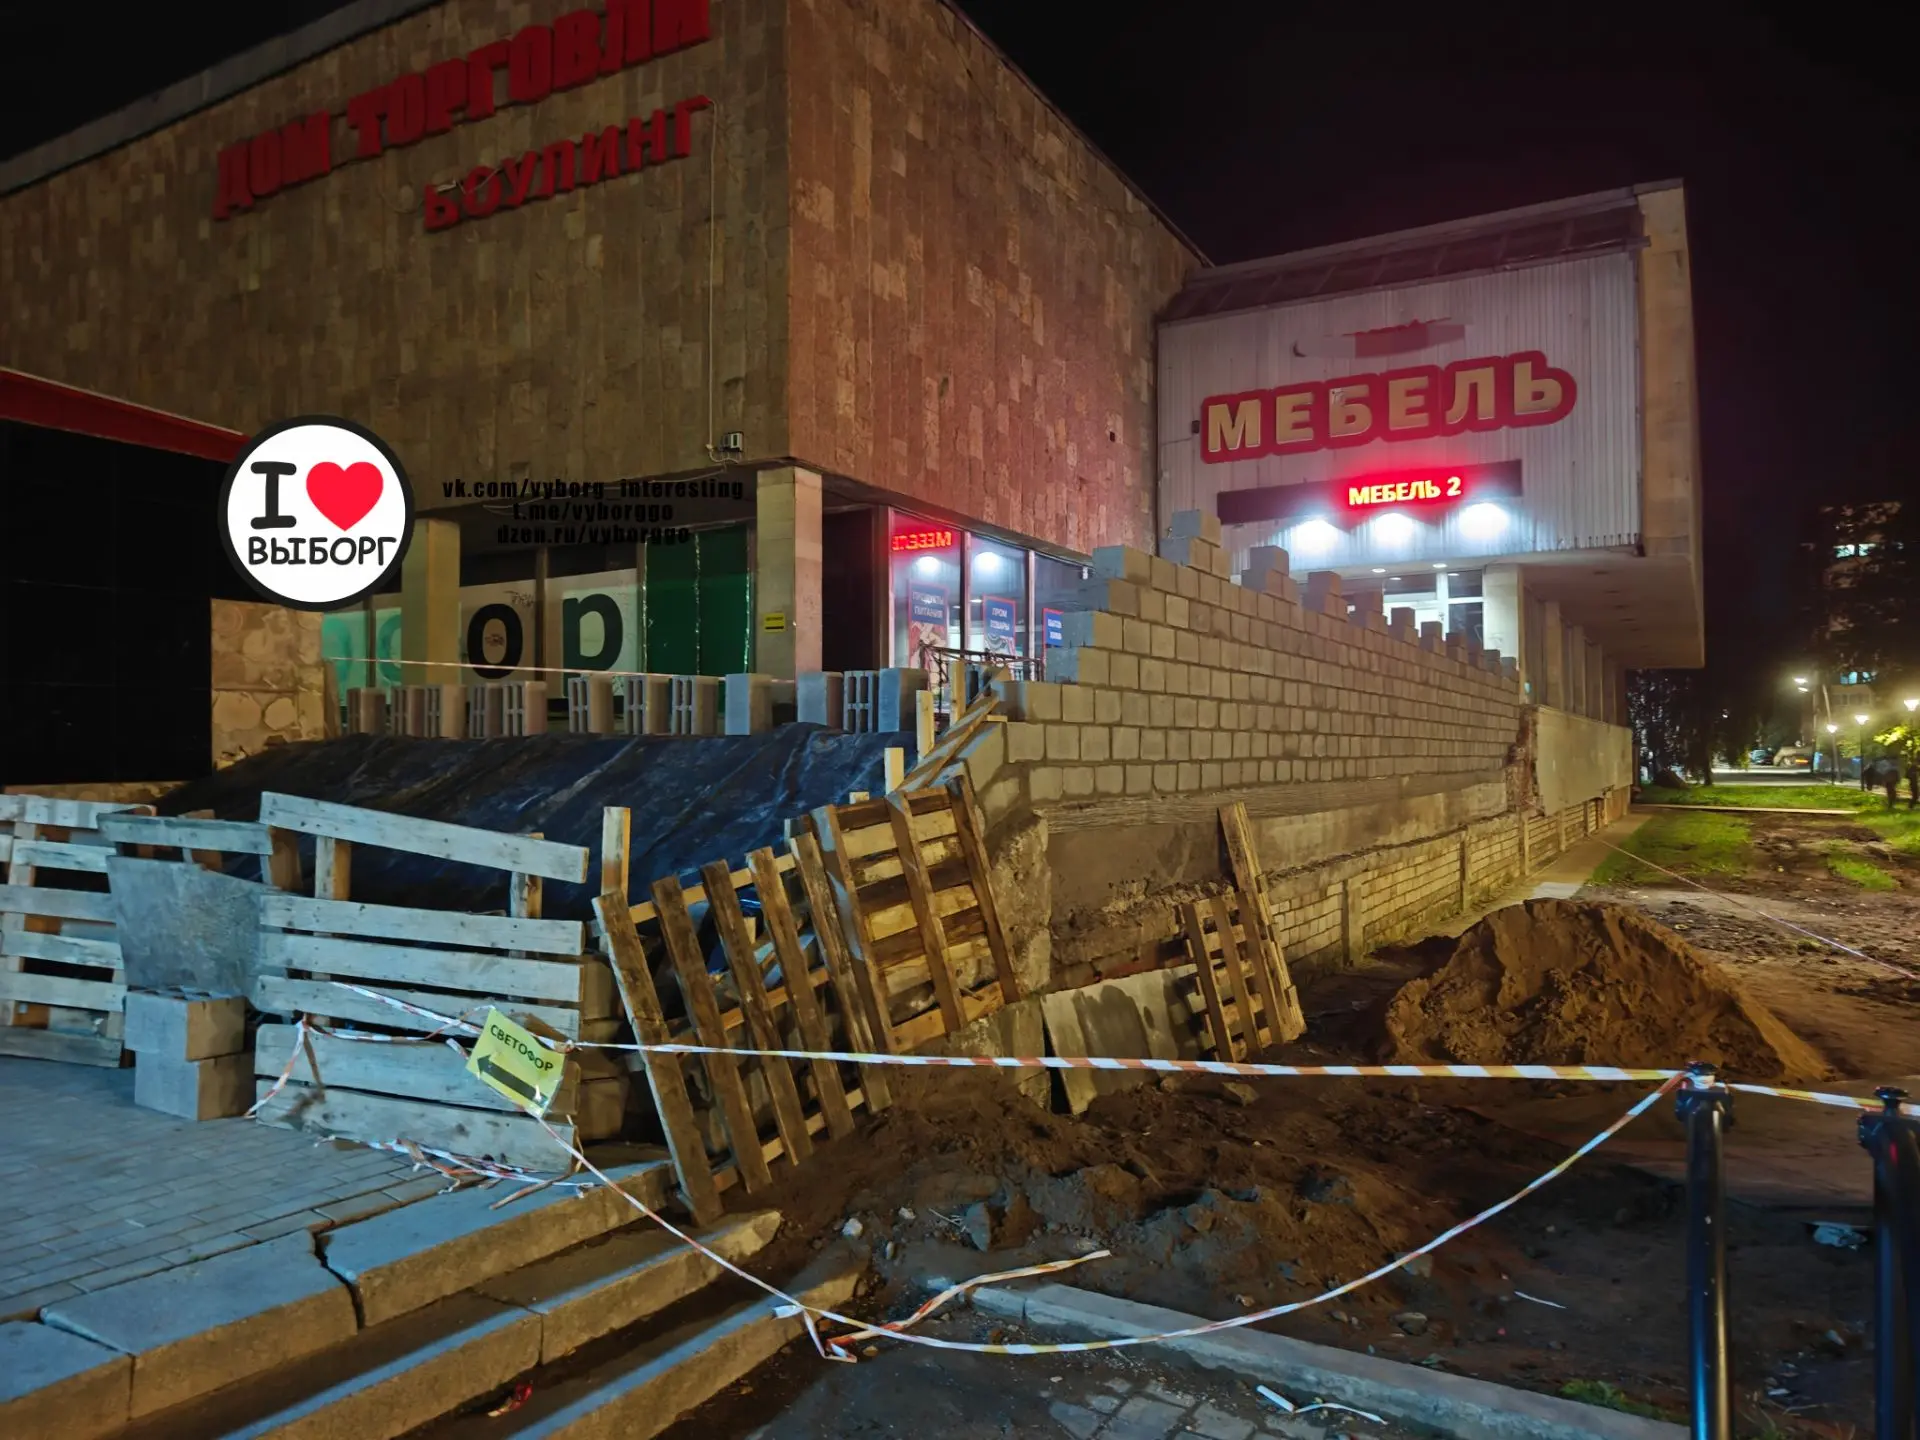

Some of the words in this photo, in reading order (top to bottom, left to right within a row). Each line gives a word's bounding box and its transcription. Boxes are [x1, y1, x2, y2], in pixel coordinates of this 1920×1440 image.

[213, 110, 330, 220] ДОМ
[347, 0, 711, 158] ТОРГОВЛИ
[1207, 360, 1563, 453] МЕБЕЛЬ
[1348, 480, 1441, 505] МЕБЕЛЬ
[1446, 476, 1461, 497] 2
[490, 1024, 554, 1071] СВЕТОФОР
